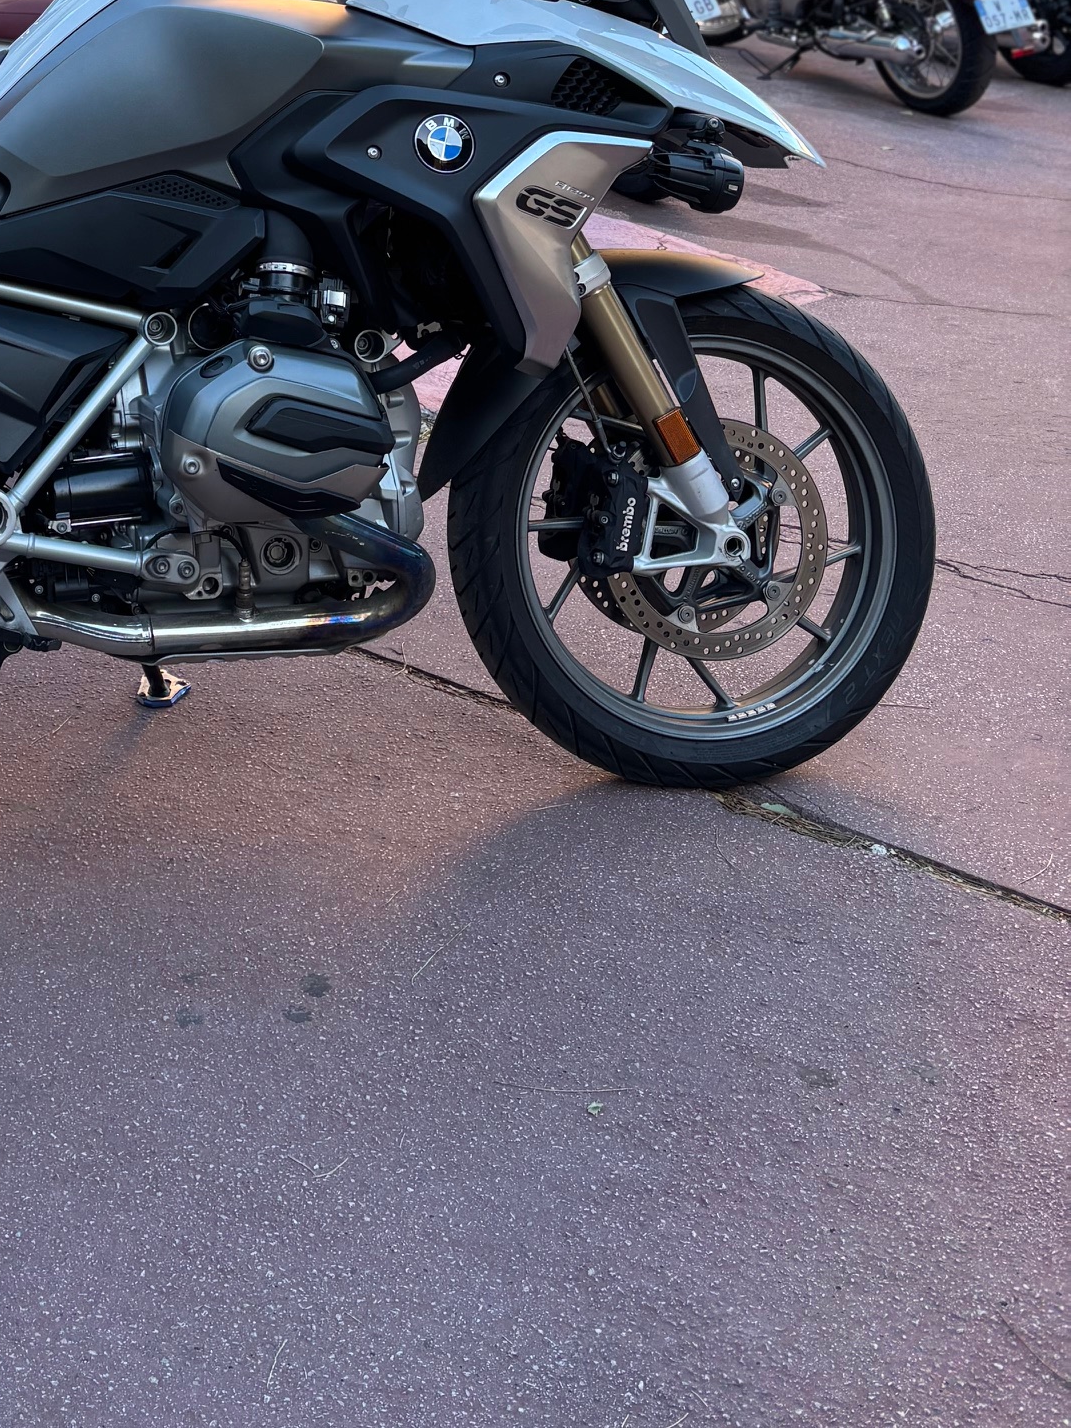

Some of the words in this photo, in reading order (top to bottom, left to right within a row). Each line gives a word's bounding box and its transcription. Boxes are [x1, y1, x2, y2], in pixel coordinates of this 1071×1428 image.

[425, 117, 471, 140] BMW
[515, 184, 588, 230] GS
[616, 497, 637, 552] brembo
